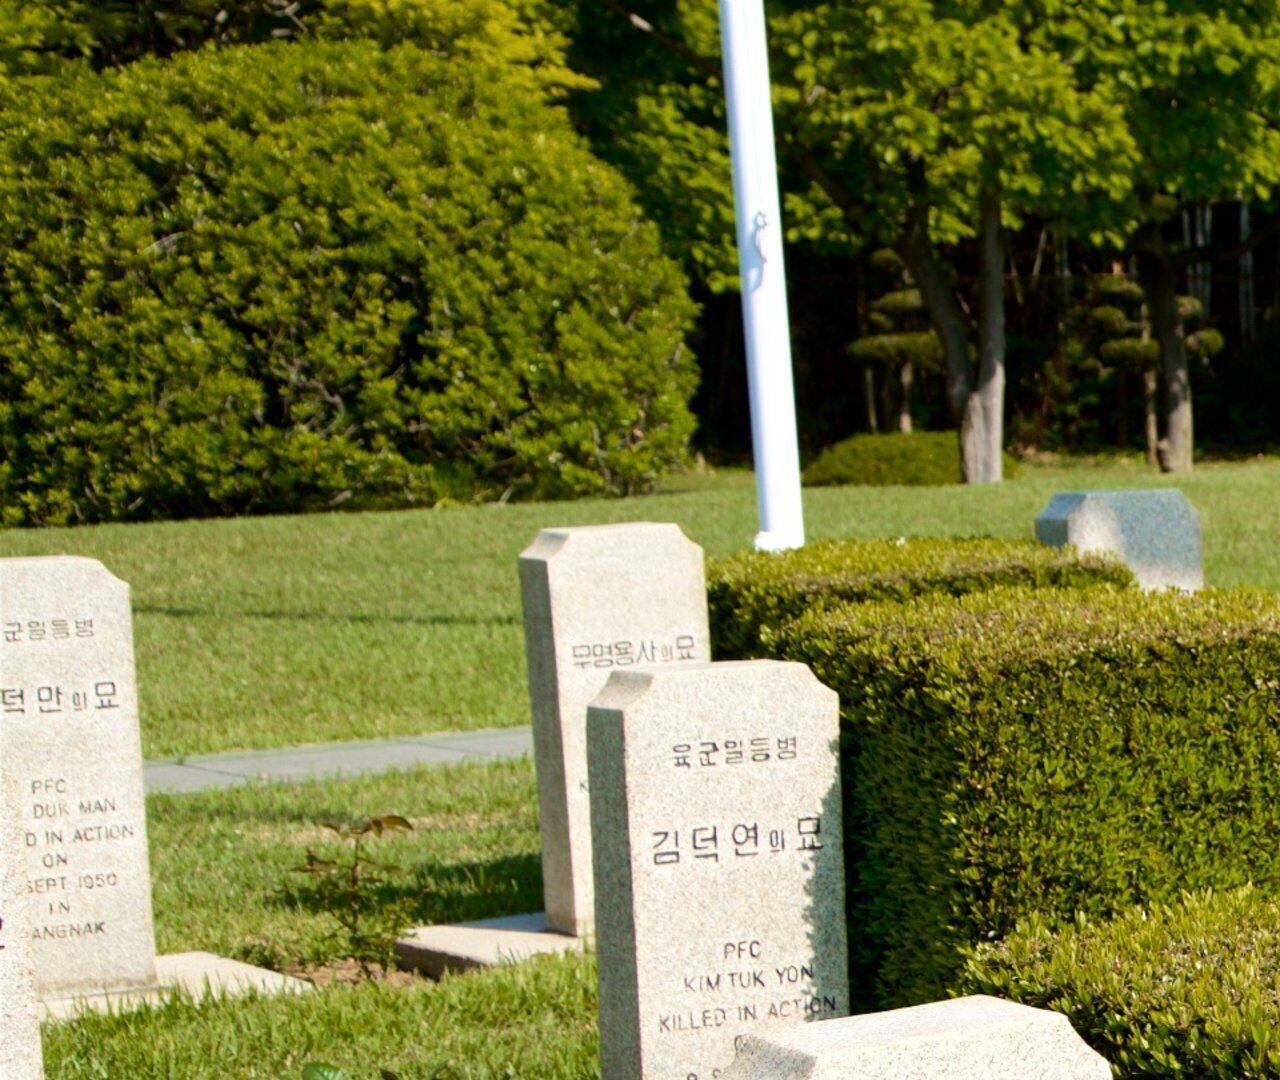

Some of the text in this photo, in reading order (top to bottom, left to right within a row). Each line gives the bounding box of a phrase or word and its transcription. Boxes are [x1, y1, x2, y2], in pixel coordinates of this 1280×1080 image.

[3, 619, 95, 643] 군일등병
[0, 681, 119, 714] 덕만의묘
[672, 736, 797, 768] 육군일등병
[32, 779, 66, 794] PFC
[33, 798, 116, 820] DUK MAN
[45, 830, 63, 844] IN
[73, 824, 134, 843] ACTION
[43, 852, 68, 868] ON
[79, 872, 117, 890] 1950
[49, 901, 71, 915] IN
[31, 921, 105, 940] ANGNAK
[723, 940, 762, 960] PFC
[683, 963, 816, 993] KIM TUK YON
[658, 995, 838, 1034] KILLED IN ACTION
